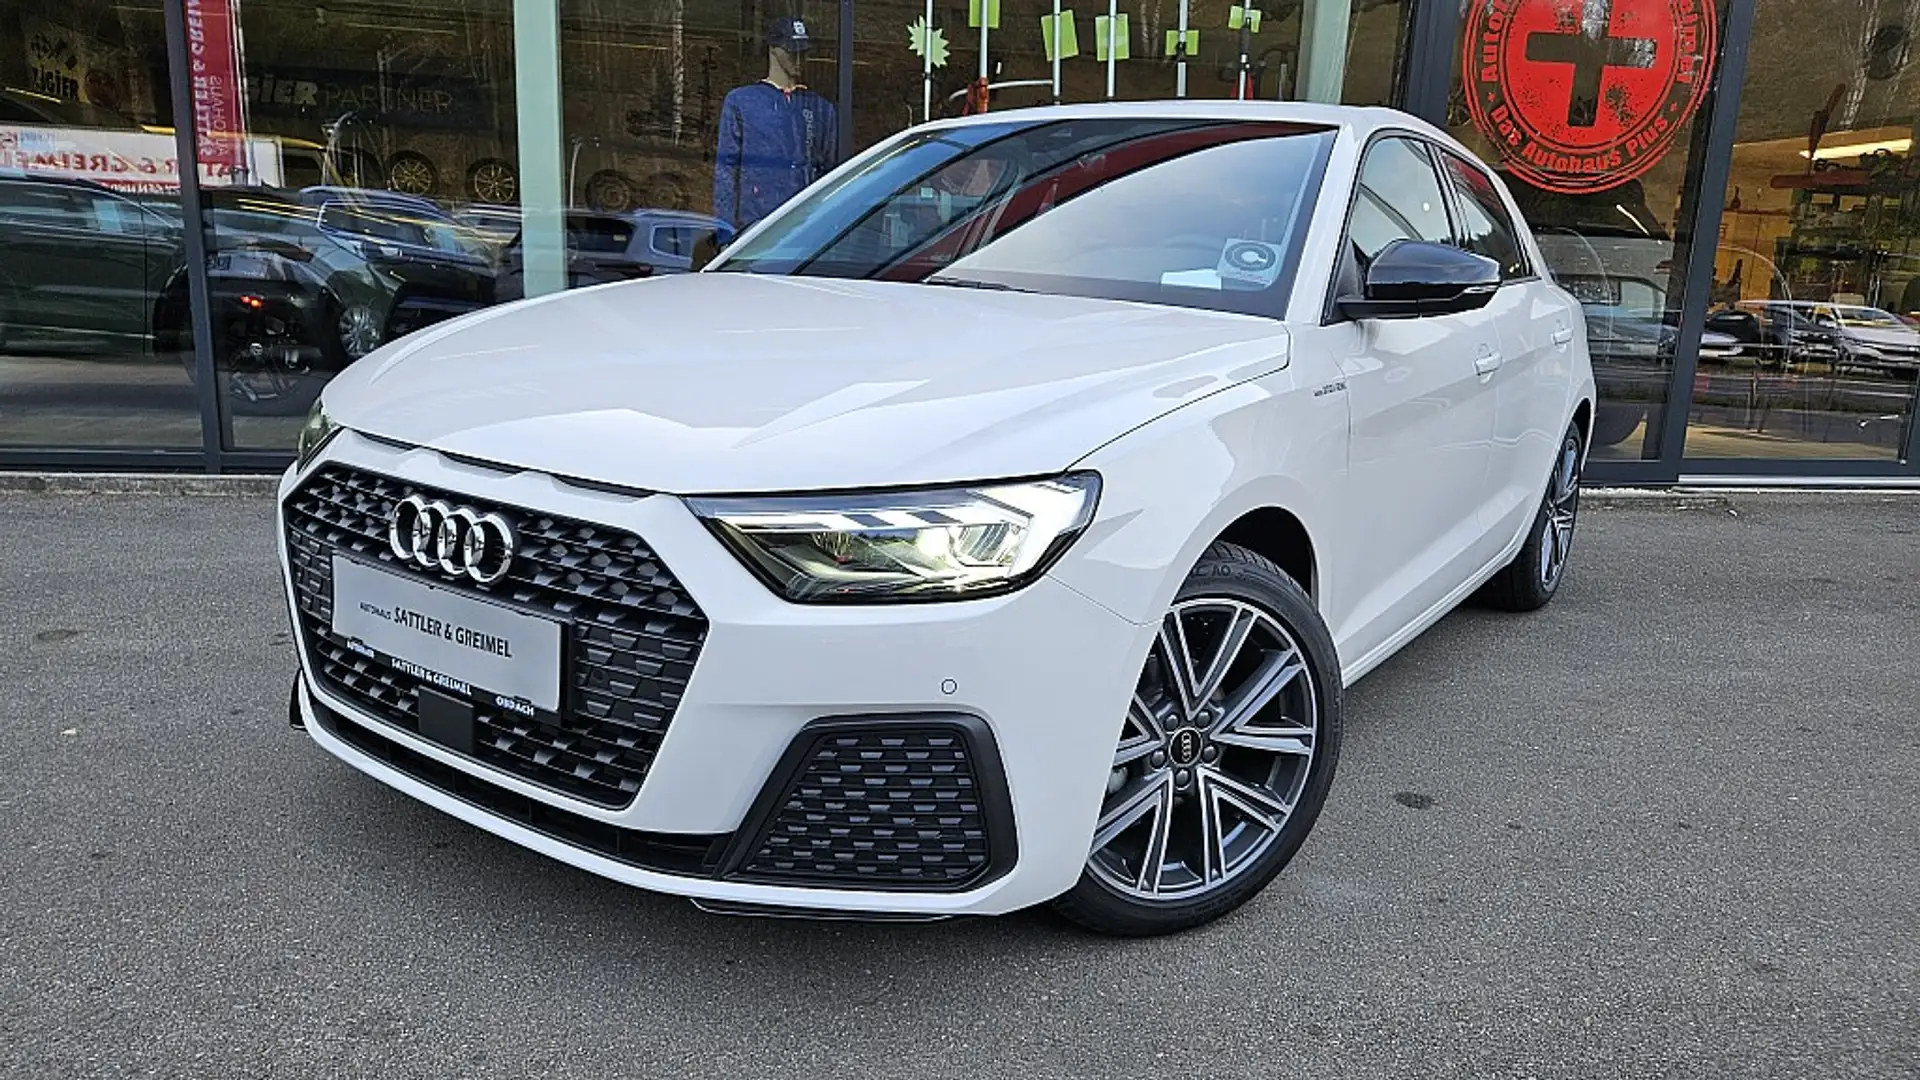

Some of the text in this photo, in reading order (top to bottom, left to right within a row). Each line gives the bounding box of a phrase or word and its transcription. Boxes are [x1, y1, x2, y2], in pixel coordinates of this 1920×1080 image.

[325, 82, 453, 113] PARTNER
[1491, 104, 1668, 174] Das Autohaus Plus
[394, 606, 442, 637] SATTLER
[444, 623, 453, 641] &
[455, 627, 512, 658] GREIMEL
